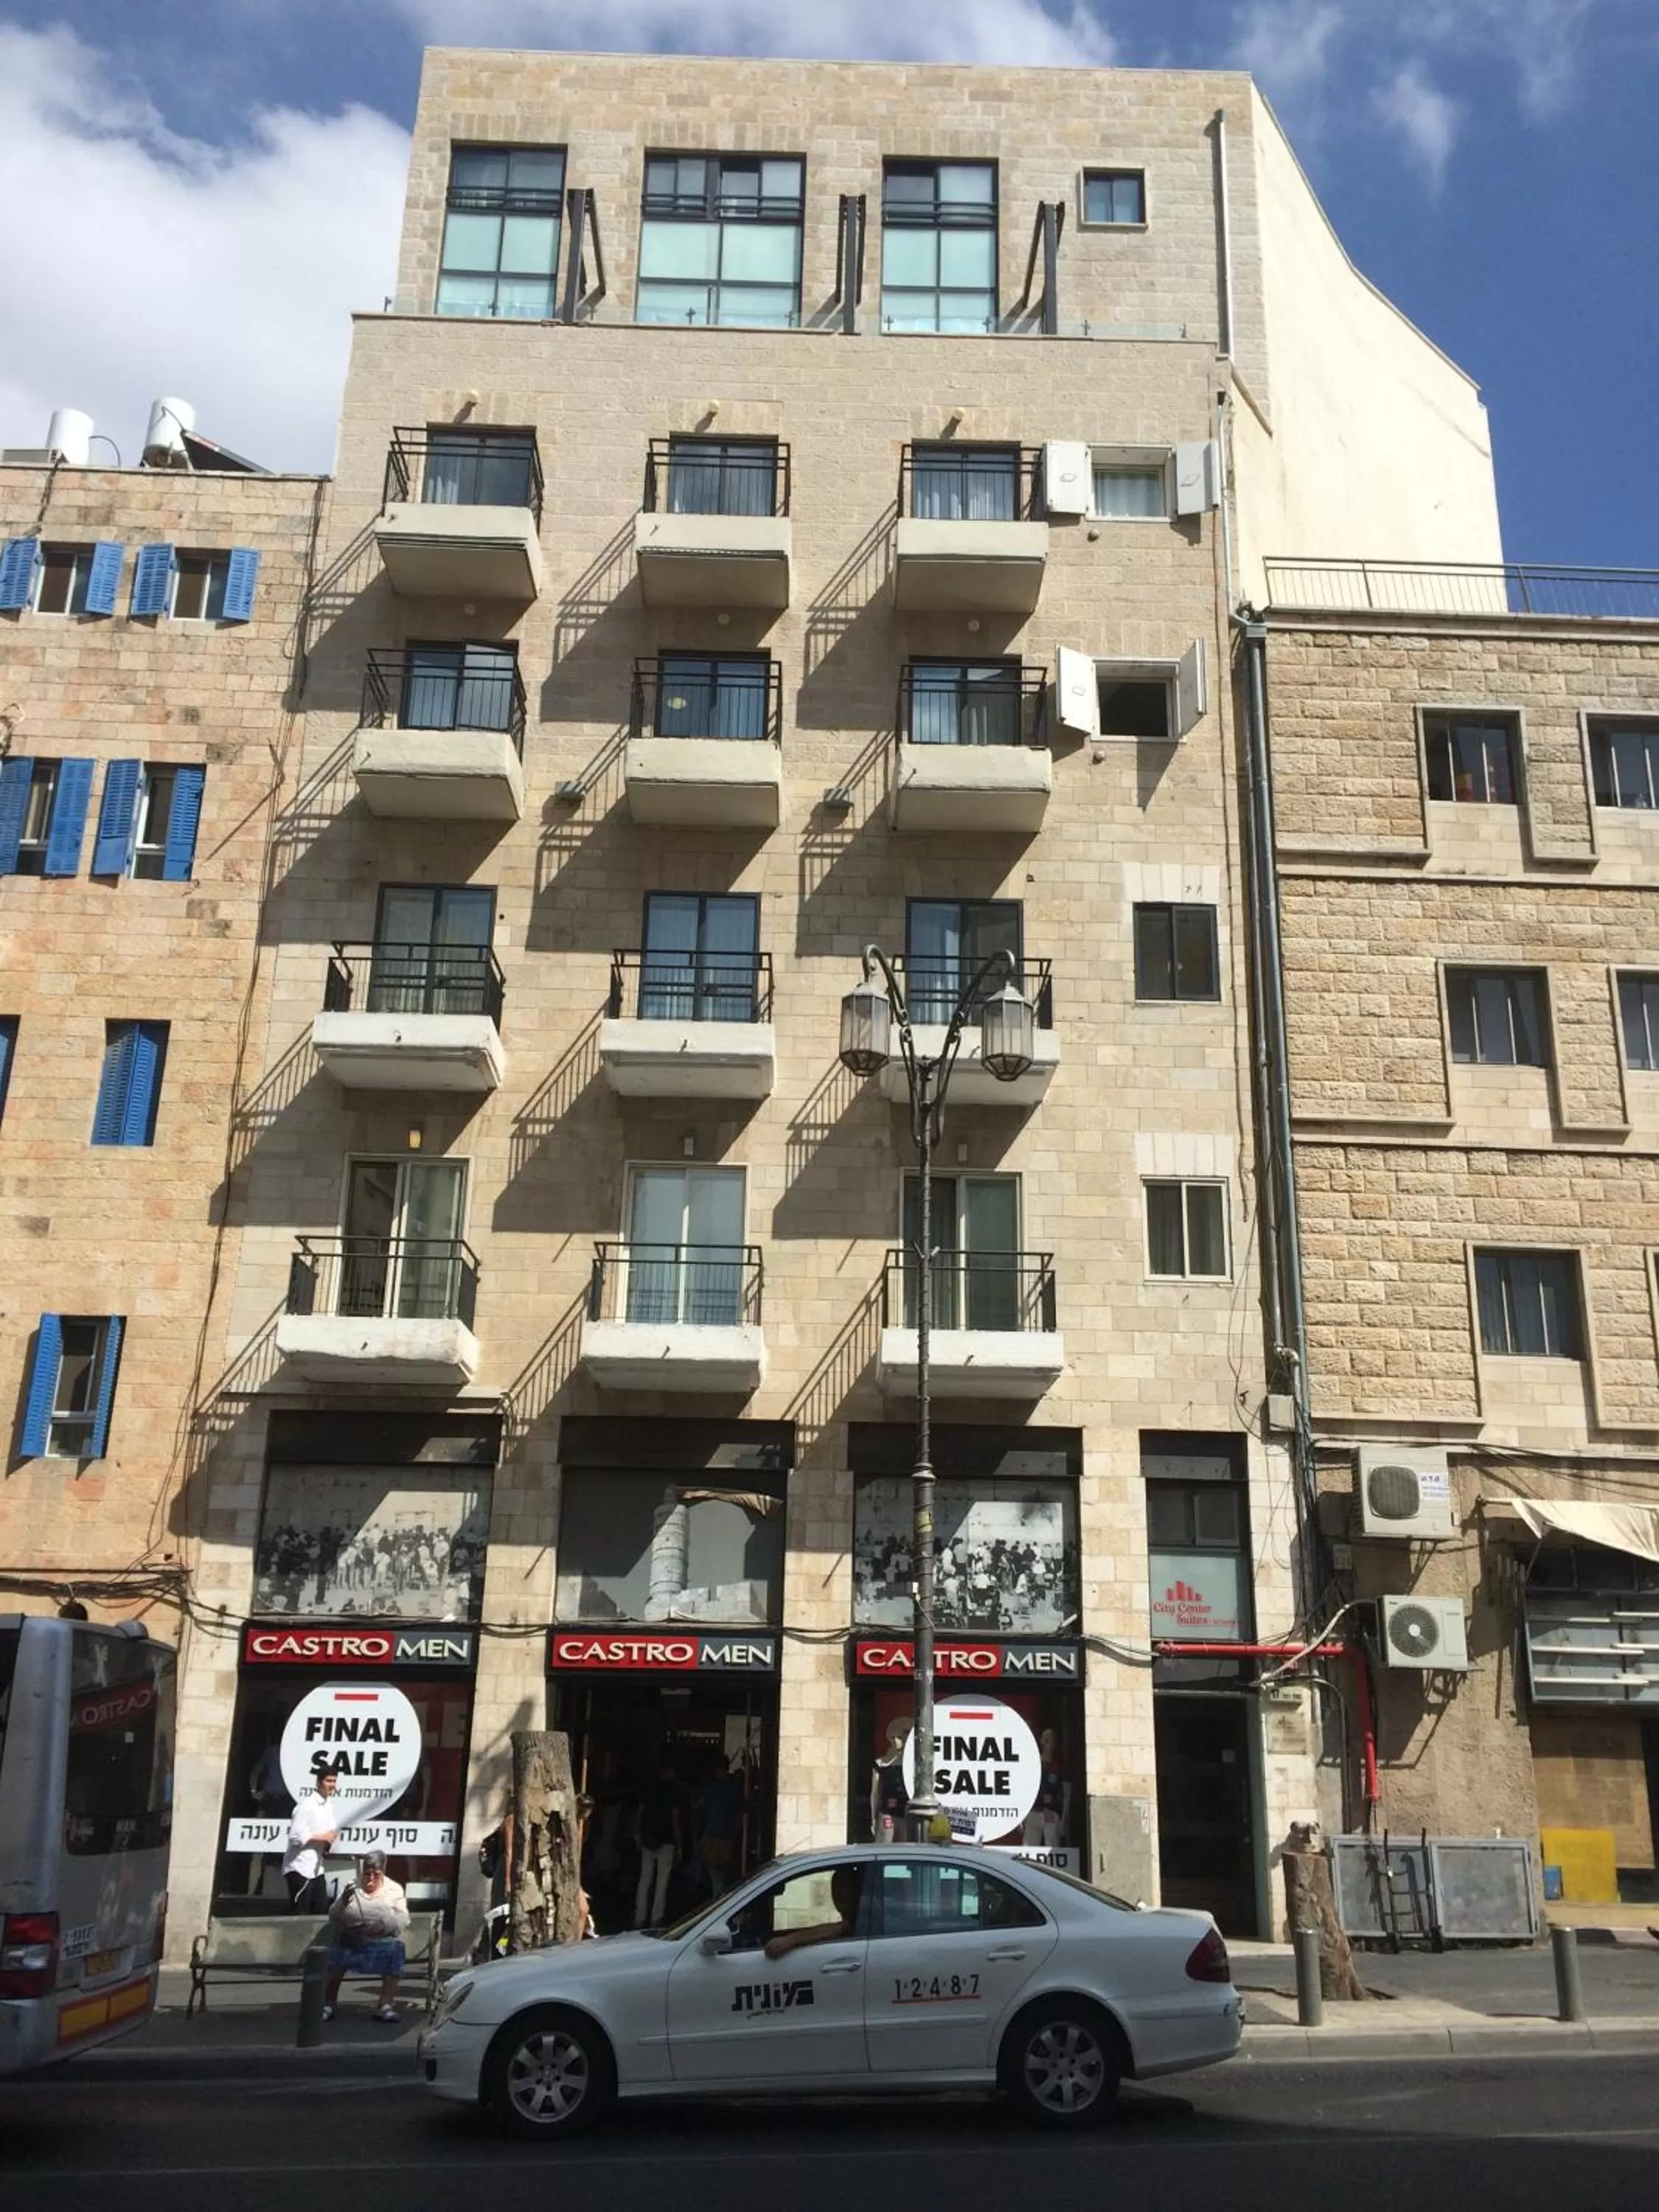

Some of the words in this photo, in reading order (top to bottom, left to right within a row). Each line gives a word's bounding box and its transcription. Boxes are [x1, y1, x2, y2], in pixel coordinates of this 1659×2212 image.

[1154, 1603, 1175, 1617] City
[1178, 1603, 1212, 1613] Center
[1178, 1613, 1208, 1624] Suites
[252, 1635, 390, 1658] CASTRO
[395, 1638, 469, 1659] MEN
[559, 1641, 695, 1663] CASTRO
[700, 1644, 772, 1664] MEN
[862, 1648, 997, 1671] CATRO
[1004, 1651, 1076, 1672] MEN
[305, 1717, 400, 1743] FINAL
[310, 1750, 389, 1776] SALE
[344, 1788, 393, 1798] הזדמנות
[934, 1770, 1011, 1795] SALE
[240, 1823, 280, 1841] עונה
[339, 1826, 380, 1843] עונה
[385, 1826, 418, 1848] סוף
[731, 1980, 814, 2011] מונית
